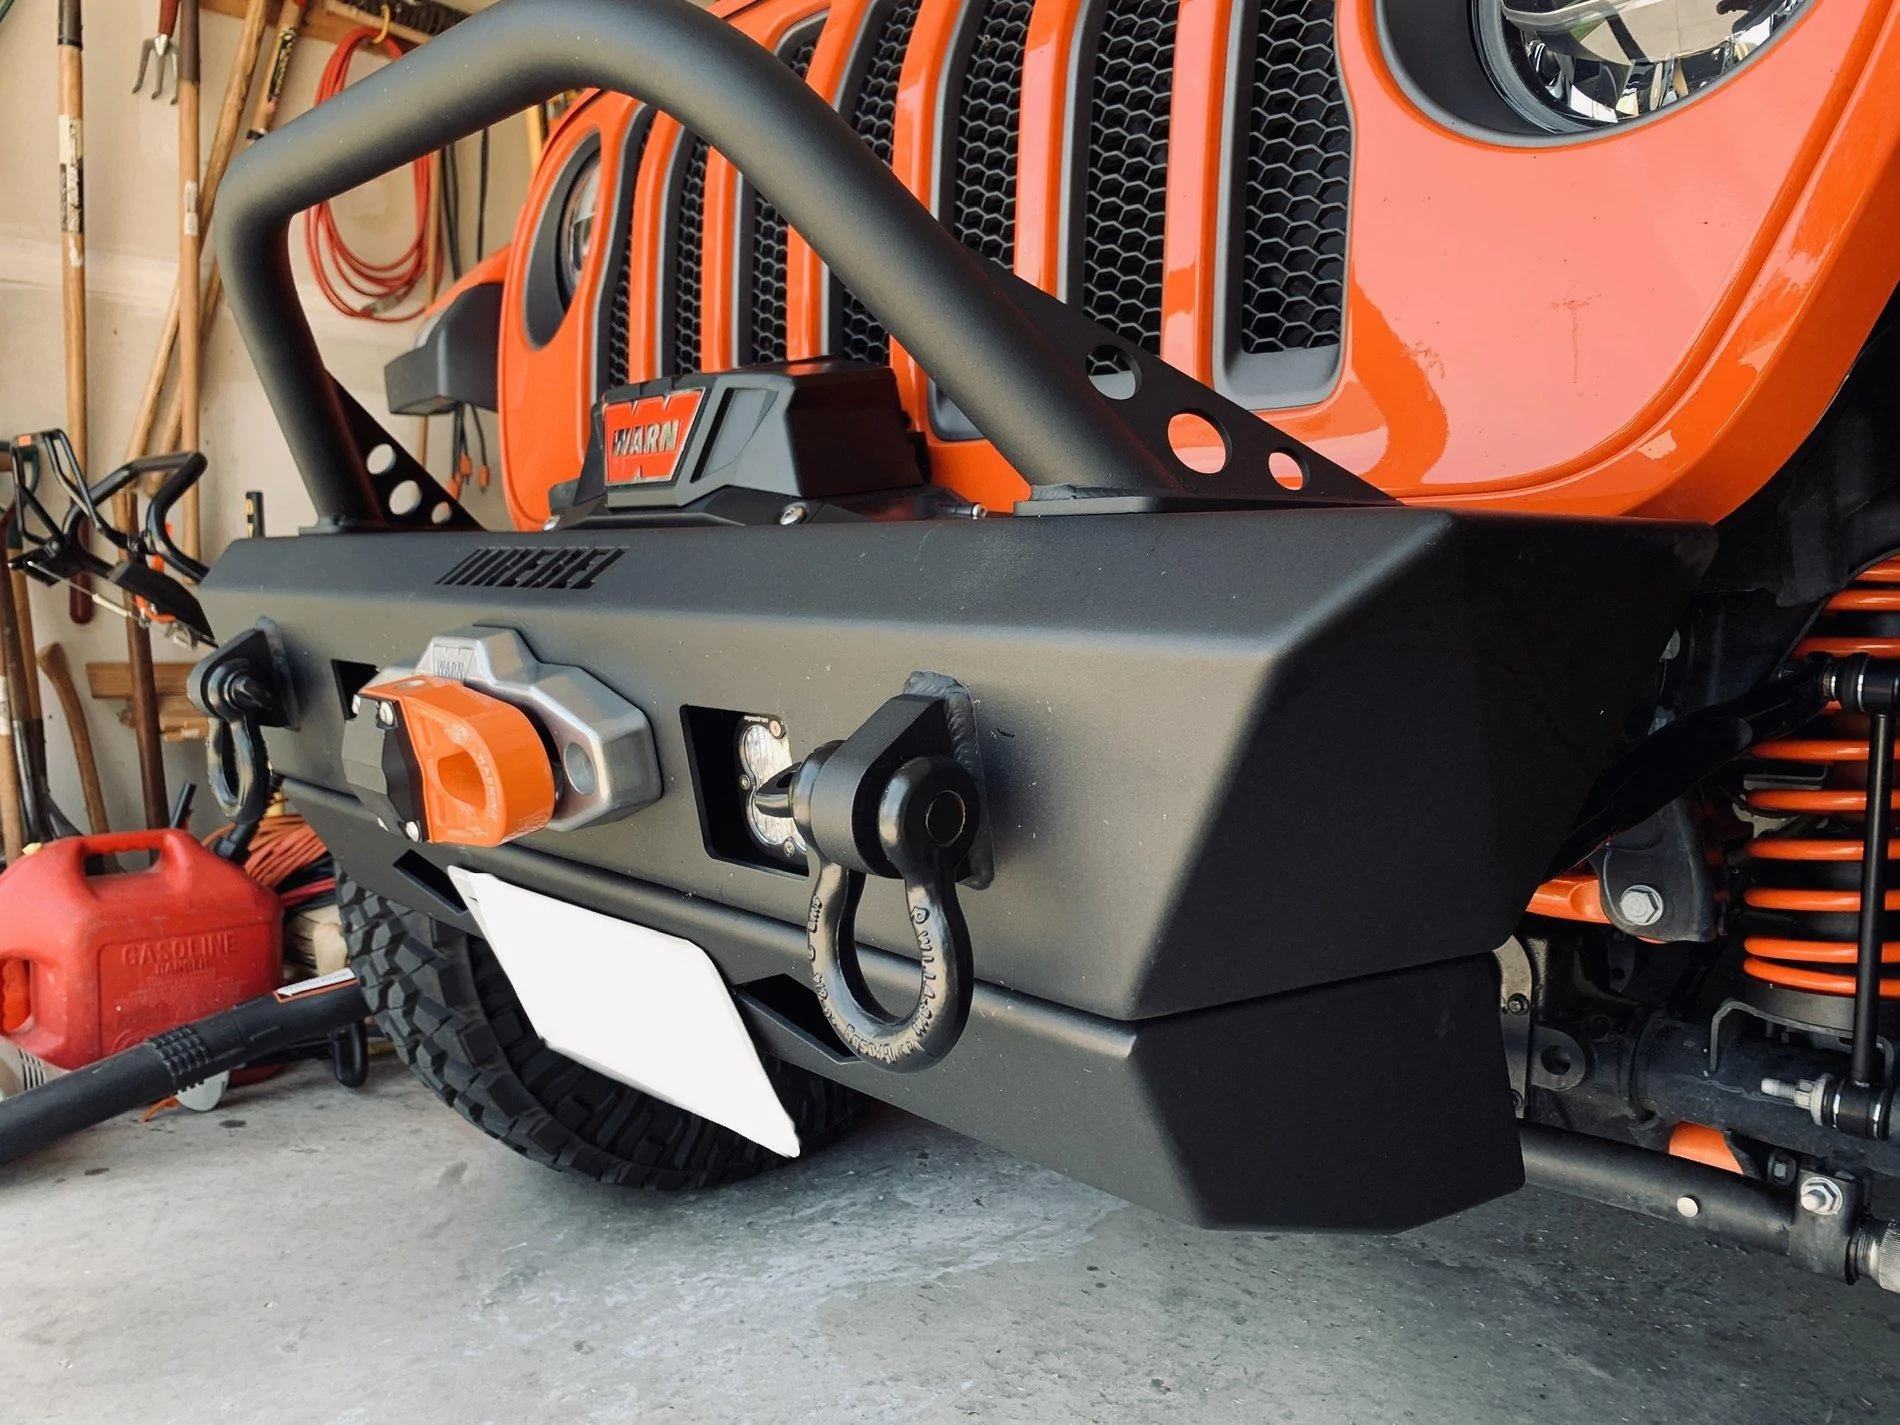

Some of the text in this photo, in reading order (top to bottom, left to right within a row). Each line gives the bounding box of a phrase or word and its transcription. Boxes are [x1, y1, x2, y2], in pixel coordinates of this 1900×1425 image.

[613, 420, 680, 457] WARN
[435, 659, 464, 679] WARN
[121, 932, 239, 966] GASOLINE
